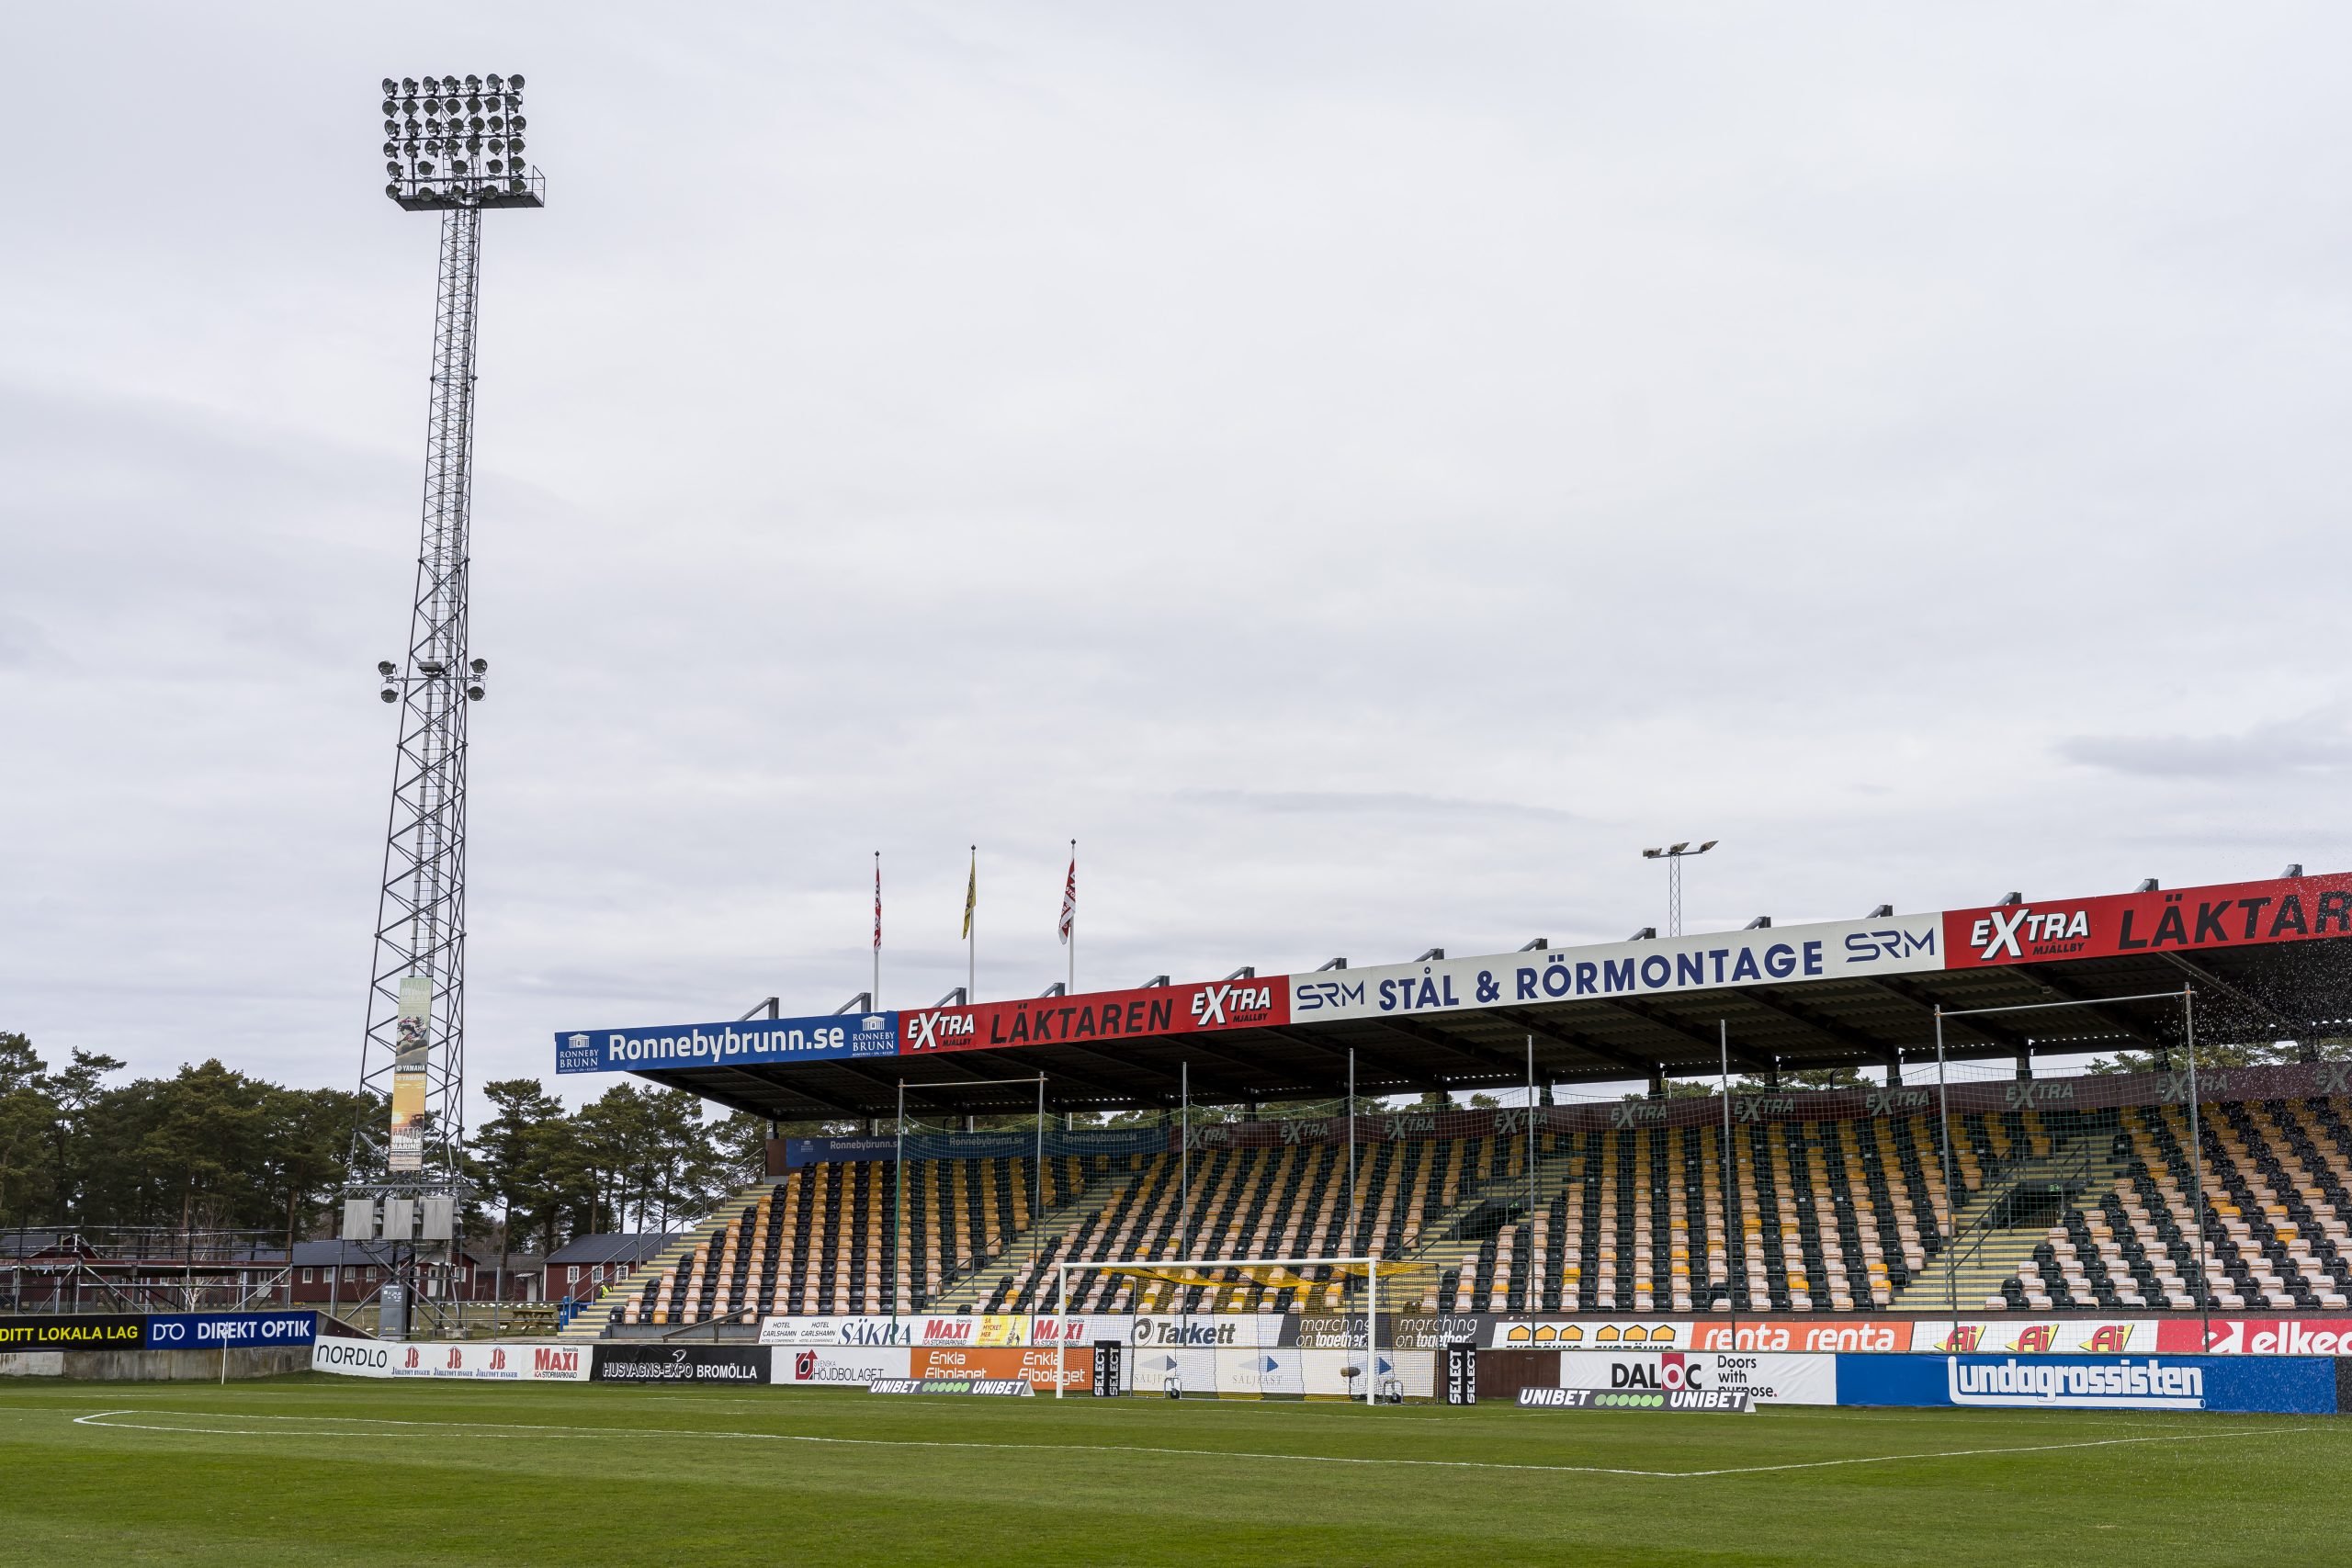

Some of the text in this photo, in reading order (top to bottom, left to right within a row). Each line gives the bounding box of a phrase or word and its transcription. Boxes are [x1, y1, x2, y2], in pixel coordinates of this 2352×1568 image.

[1845, 927, 1935, 963] SRM
[1970, 908, 2090, 961] EXTRA
[2032, 942, 2086, 955] MJÄLLBY
[1378, 941, 1823, 1011] STÅL & RÖRMONTAGE
[1191, 984, 1272, 1026] EXTRA
[1296, 980, 1365, 1010] SRM
[989, 998, 1173, 1044] LÄKTAREN
[1233, 1012, 1268, 1022] MJÄLLBY
[853, 1032, 895, 1041] RONNEBY
[908, 1011, 975, 1049] EXTRA
[608, 1027, 844, 1062] Ronnebybrunn.se
[853, 1041, 894, 1051] BRUNN
[943, 1038, 972, 1047] MJÄLLBY
[560, 1049, 599, 1058] RONNEBY
[560, 1057, 598, 1068] BRUNN
[2006, 1080, 2074, 1109] EXTRA
[2154, 1069, 2228, 1102] EXRA
[1734, 1097, 1794, 1122] EXTRA
[1865, 1089, 1931, 1117] EXTRA
[1610, 1102, 1668, 1129] EXTRA
[1280, 1121, 1329, 1145] EXTRA
[1384, 1115, 1435, 1140] EXTRA
[831, 1139, 898, 1151] Ronnebybrunn.s
[949, 1136, 1024, 1146] Ronnebybrunn.se
[1063, 1134, 1136, 1144] Ronnebybrunn.se
[0, 1325, 139, 1341] DITT LOKALA LAG
[198, 1320, 311, 1339] DIREKT OPTIK
[838, 1317, 910, 1345] SÄKRA
[924, 1320, 971, 1339] MAXI
[1034, 1320, 1084, 1339] MAXI
[1157, 1323, 1236, 1345] Tarkett
[1399, 1315, 1477, 1336] marching
[1296, 1335, 1313, 1347] on
[1396, 1335, 1413, 1348] on
[1705, 1324, 1894, 1351] renta renta
[2018, 1325, 2050, 1352] Ai
[2092, 1325, 2125, 1352] Ai
[535, 1348, 579, 1371] MAXI
[930, 1351, 967, 1365] Enkla
[1023, 1352, 1058, 1366] Enkla
[1718, 1355, 1757, 1369] Doors
[603, 1362, 757, 1379] HUSVAGNS-EXPO BROMÖLLA
[813, 1366, 884, 1382] HÖJDBOLAGET
[1094, 1348, 1105, 1396] SELECT
[1110, 1348, 1119, 1396] SELECT
[1450, 1350, 1462, 1404] SELECT
[1467, 1350, 1476, 1404] SELECT
[1611, 1363, 1702, 1389] DALOC
[1718, 1370, 1747, 1383] with
[870, 1380, 921, 1394] UNIBET
[972, 1381, 1024, 1395] UNIBET
[1948, 1356, 2204, 1408] Lundagrossisten
[1520, 1389, 1590, 1406] UNIBET
[1670, 1392, 1746, 1408] UNIBET
